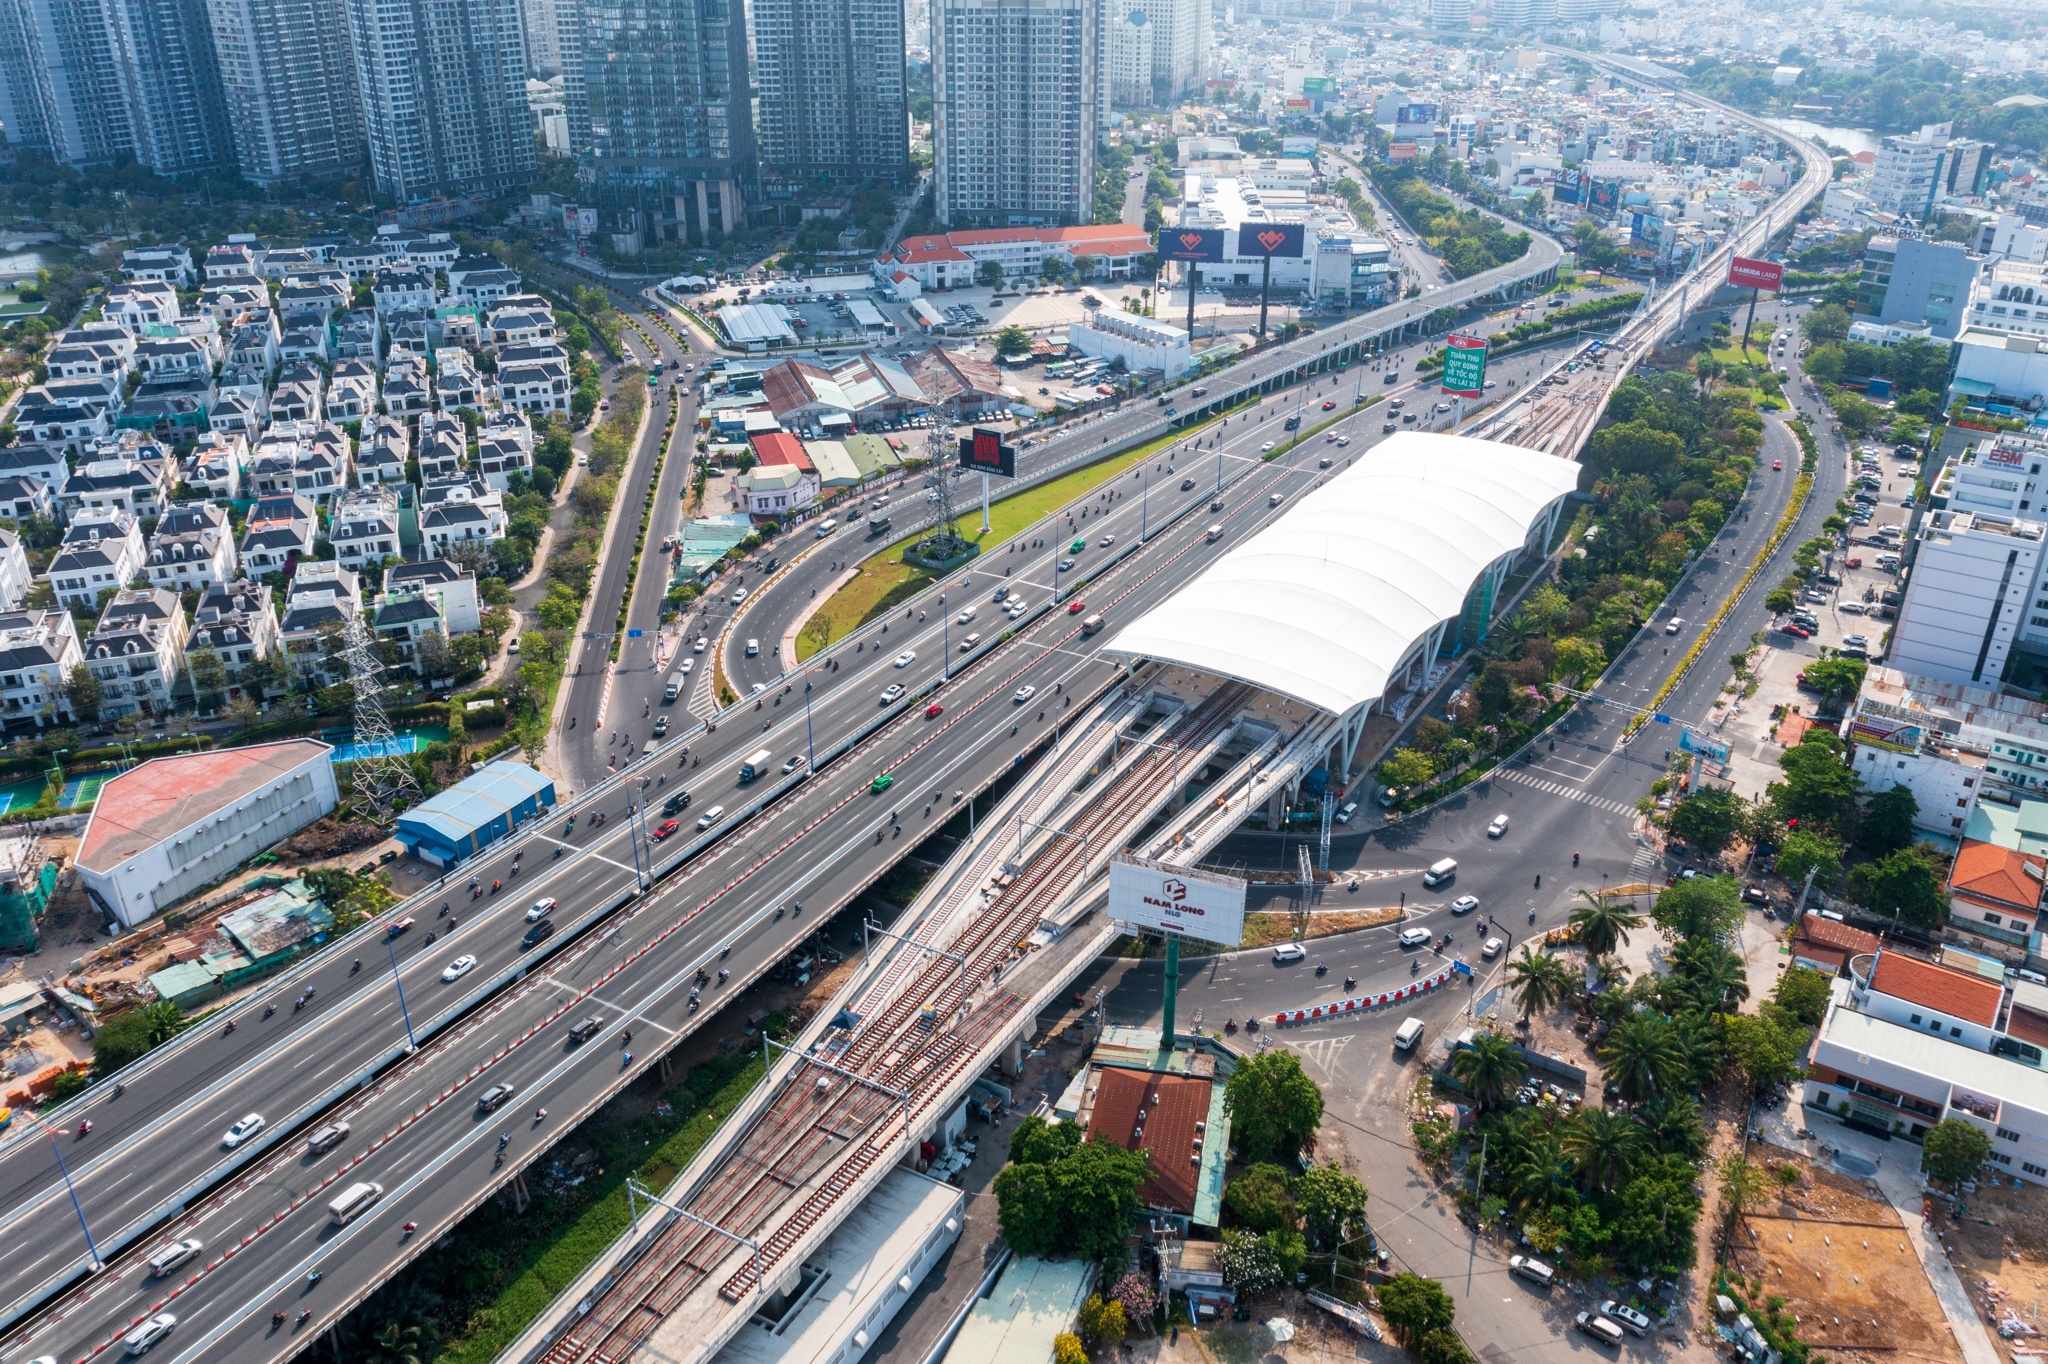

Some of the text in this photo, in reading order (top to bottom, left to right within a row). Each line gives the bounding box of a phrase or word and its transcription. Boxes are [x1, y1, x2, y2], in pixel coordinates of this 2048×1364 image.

[1733, 266, 1760, 276] GAMUDA
[1761, 271, 1778, 279] LAND
[1462, 362, 1479, 371] ĐỊNH
[1458, 378, 1468, 386] LÁI
[1989, 449, 2024, 465] EBM
[1144, 896, 1205, 916] NAM LONG
[1164, 908, 1181, 918] NLG
